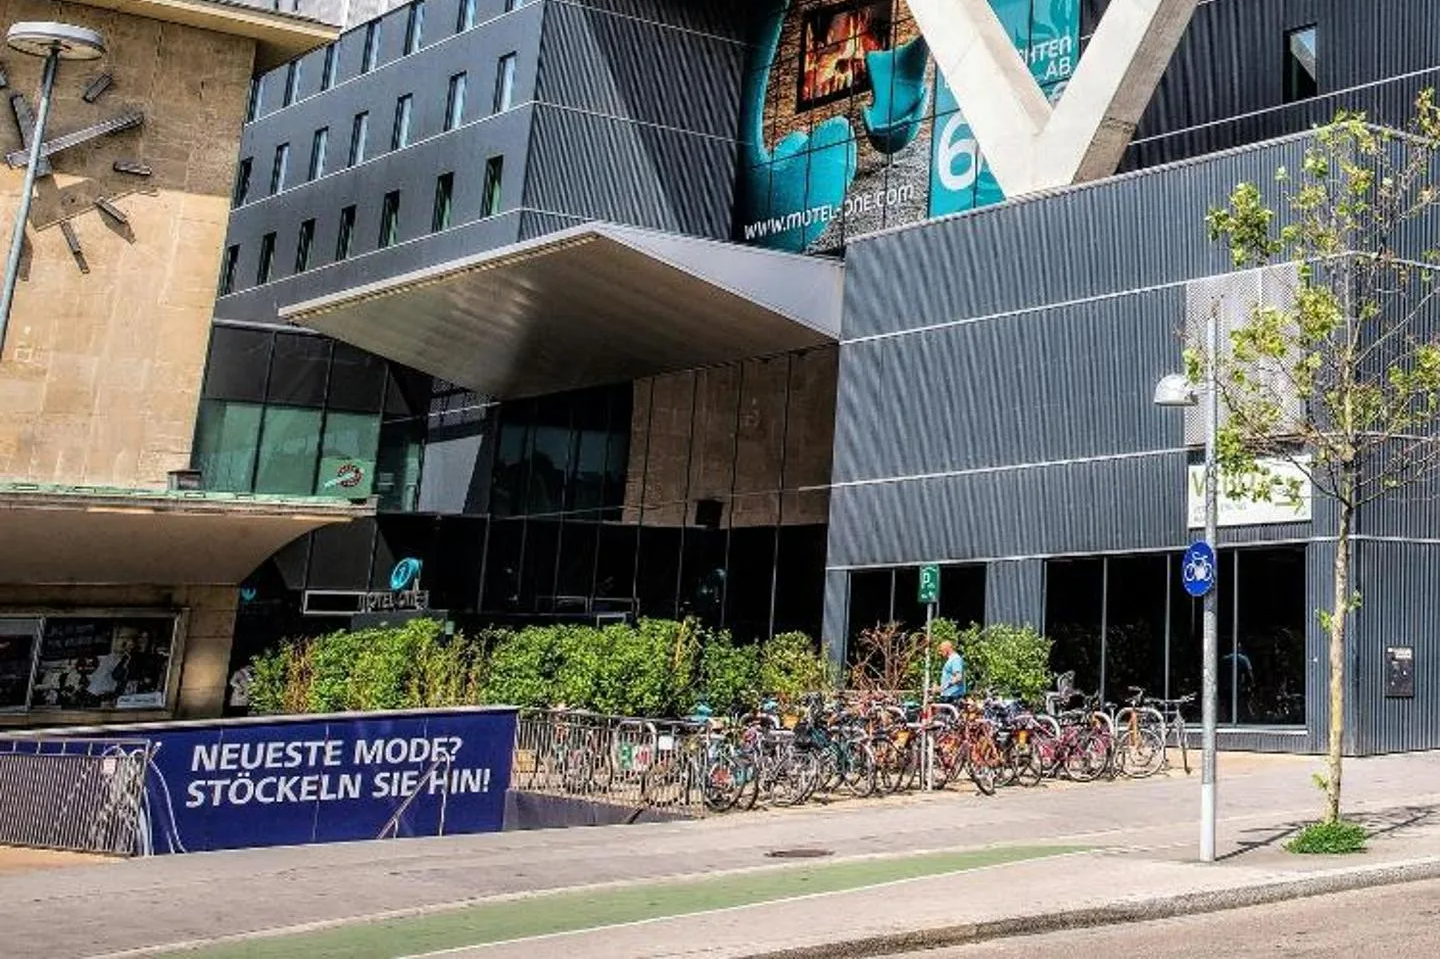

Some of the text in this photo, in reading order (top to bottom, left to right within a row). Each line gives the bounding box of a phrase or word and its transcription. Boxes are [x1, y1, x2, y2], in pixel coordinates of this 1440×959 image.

[1045, 56, 1071, 80] AB
[191, 737, 463, 772] NEUESTE MODE?
[185, 768, 491, 809] STÖCKELN SIE HIN!
